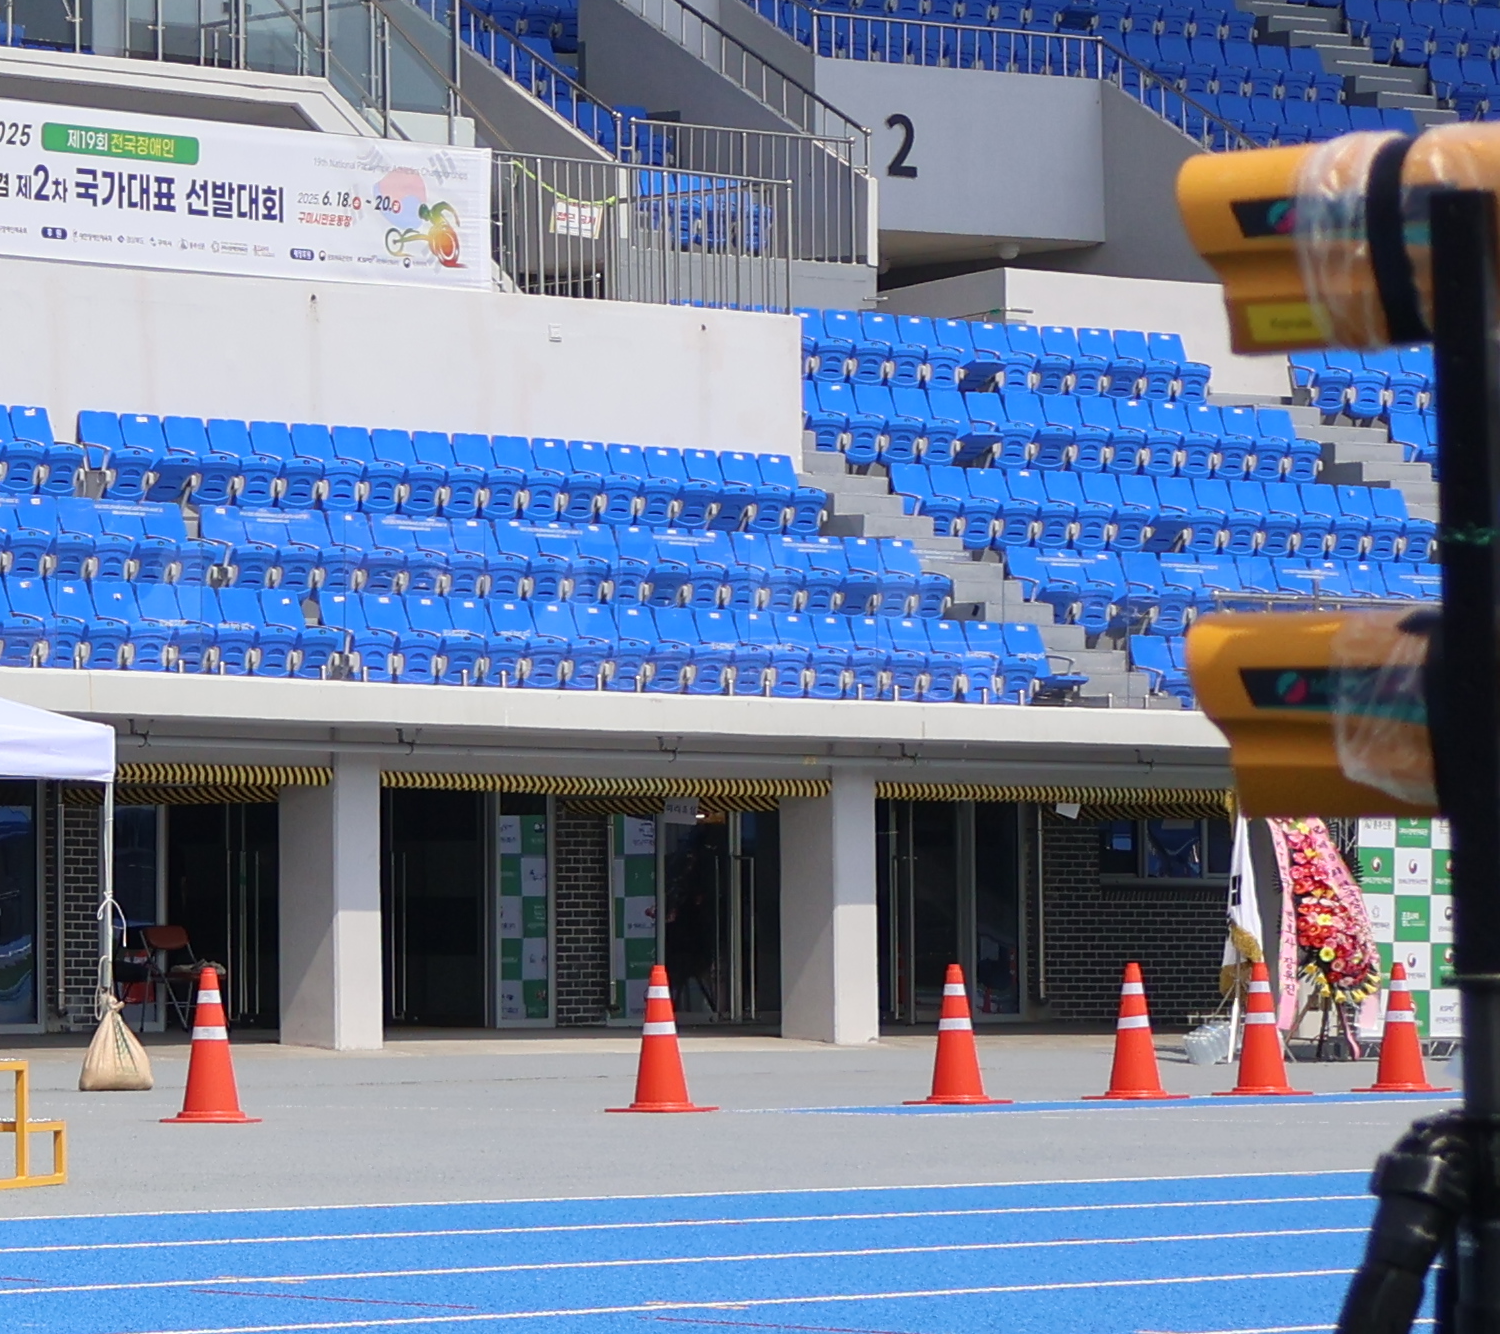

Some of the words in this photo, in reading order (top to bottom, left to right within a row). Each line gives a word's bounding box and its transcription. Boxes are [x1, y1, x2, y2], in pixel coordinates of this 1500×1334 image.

[66, 127, 109, 153] 제19회
[110, 132, 176, 159] 전국장애인
[885, 112, 919, 179] 2
[16, 163, 69, 204] 제2차
[74, 166, 177, 214] 국가대표
[185, 178, 285, 224] 선발대회
